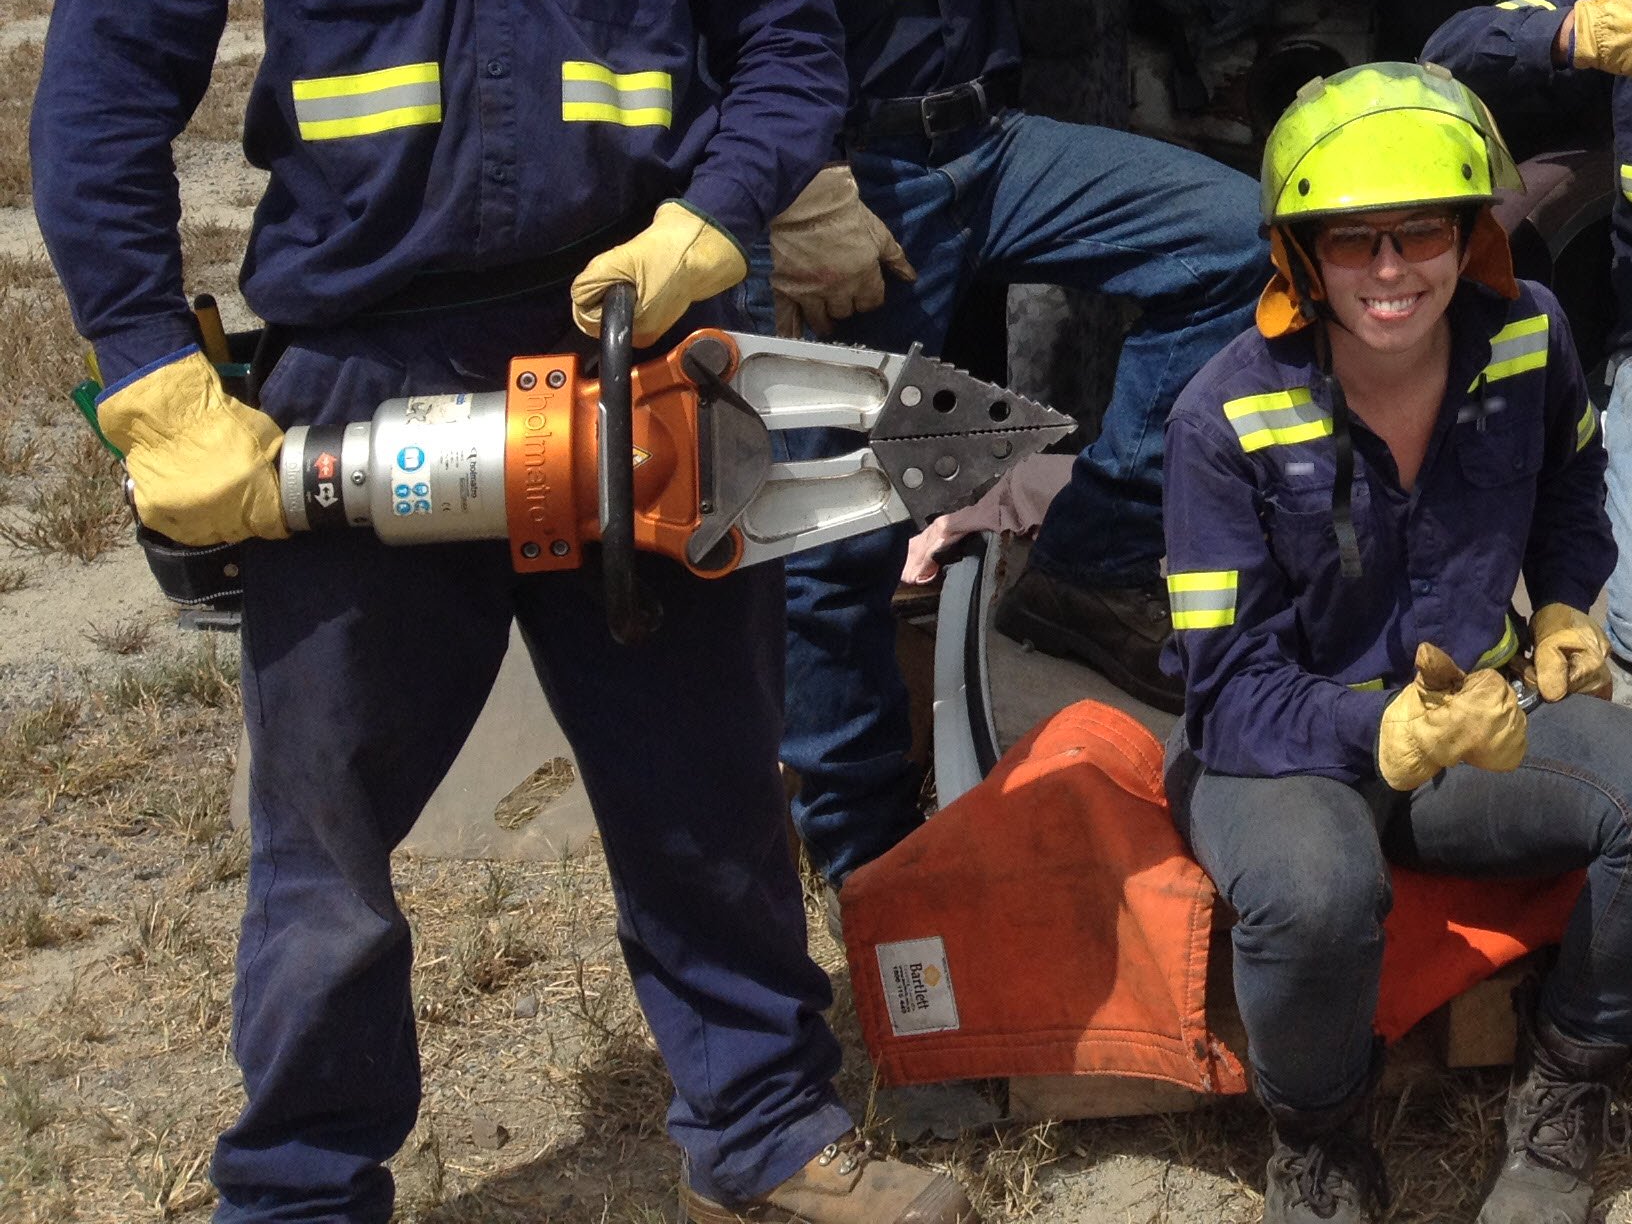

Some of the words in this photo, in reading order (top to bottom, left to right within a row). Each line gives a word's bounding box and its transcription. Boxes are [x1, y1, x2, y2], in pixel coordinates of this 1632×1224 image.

[469, 461, 478, 499] holmatro
[524, 393, 555, 523] holmatro
[909, 962, 930, 1010] Bartlett
